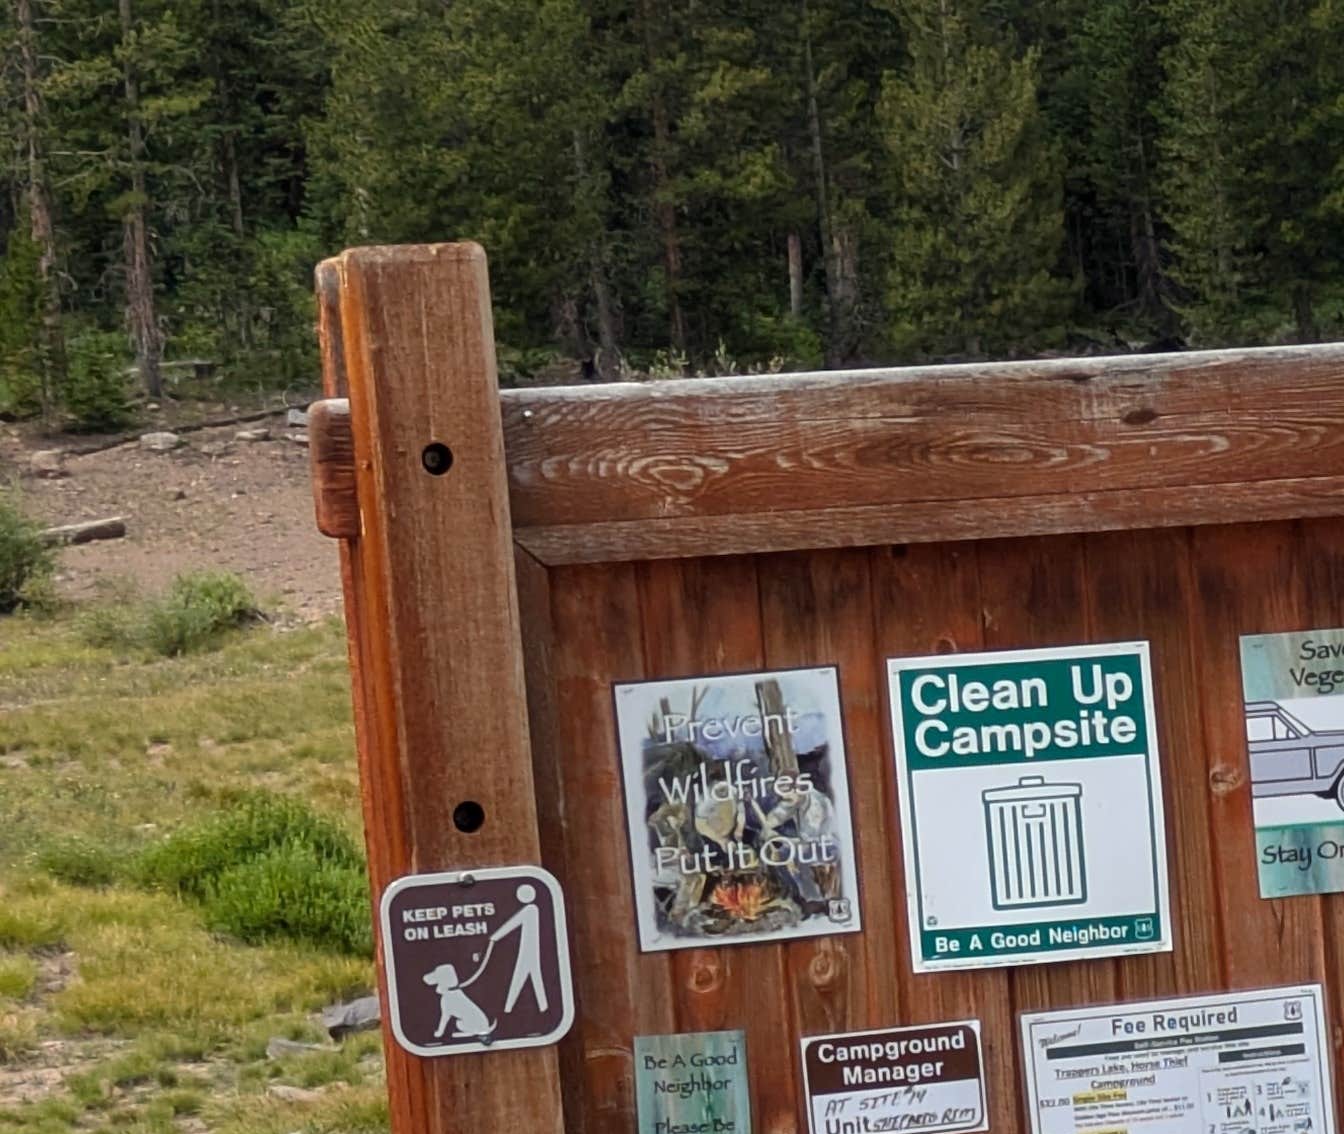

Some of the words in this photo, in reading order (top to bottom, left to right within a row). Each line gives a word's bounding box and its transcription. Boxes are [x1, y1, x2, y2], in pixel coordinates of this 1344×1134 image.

[911, 673, 1048, 715] Clean
[1071, 664, 1133, 710] Up
[663, 707, 801, 744] Prevent
[914, 710, 1137, 757] Campsite
[658, 758, 814, 804] Wildfires
[654, 843, 721, 875] Put
[726, 841, 751, 870] It
[760, 836, 835, 867] Out
[1261, 844, 1312, 871] Stay
[402, 907, 447, 923] KEEP
[452, 902, 495, 918] PETS
[404, 927, 429, 941] ON
[433, 922, 488, 939] LEASH
[935, 936, 960, 954] Be
[969, 934, 983, 951] A
[991, 929, 1041, 949] Good
[1049, 923, 1129, 946] Neighbor
[1112, 1017, 1147, 1037] Fee
[1152, 1006, 1239, 1032] Required
[644, 1055, 667, 1070] Be
[672, 1054, 687, 1068] A
[691, 1046, 737, 1068] Good
[818, 1030, 965, 1063] Campground
[654, 1072, 732, 1099] Neighbor
[842, 1061, 944, 1086] Manager
[712, 1118, 736, 1132] Be
